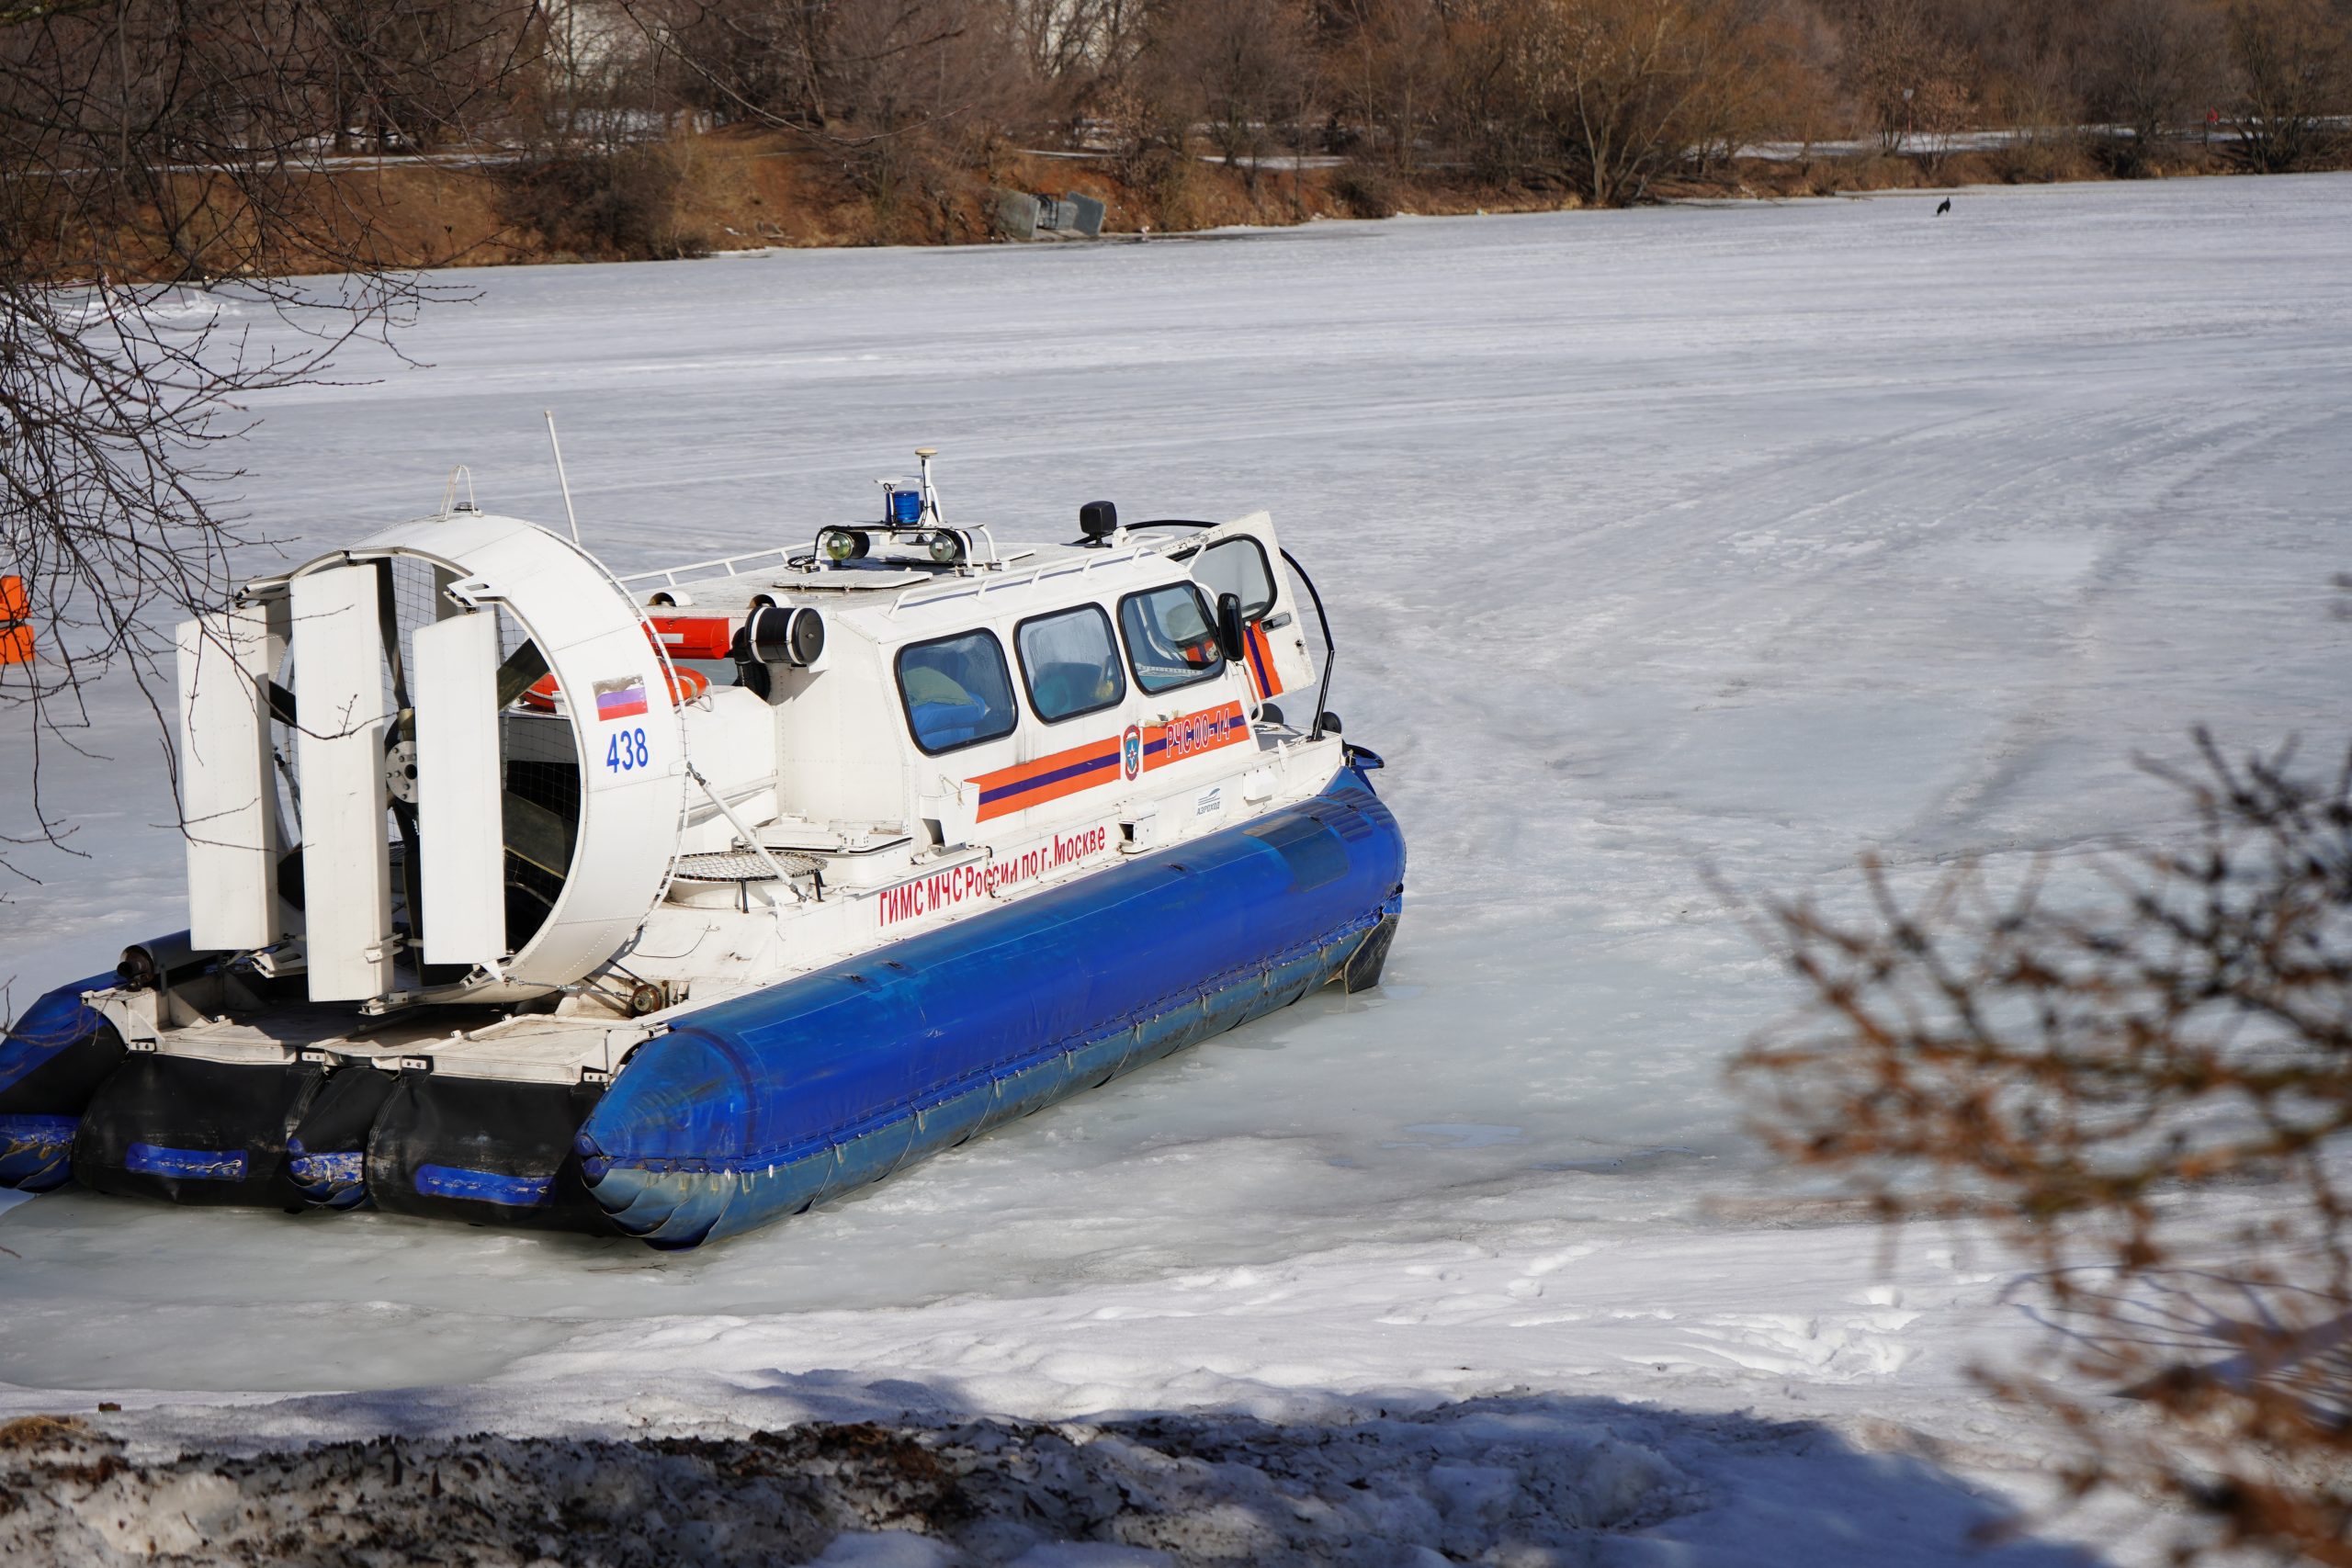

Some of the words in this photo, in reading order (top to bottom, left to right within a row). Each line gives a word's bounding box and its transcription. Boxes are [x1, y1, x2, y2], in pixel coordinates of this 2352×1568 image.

[606, 728, 648, 773] 438
[1167, 719, 1191, 758] РЧС
[1194, 708, 1230, 750] 00-14
[879, 880, 923, 927] ГИМС
[928, 867, 962, 912] МЧС
[1022, 851, 1037, 879] по
[1054, 826, 1105, 868] Москве
